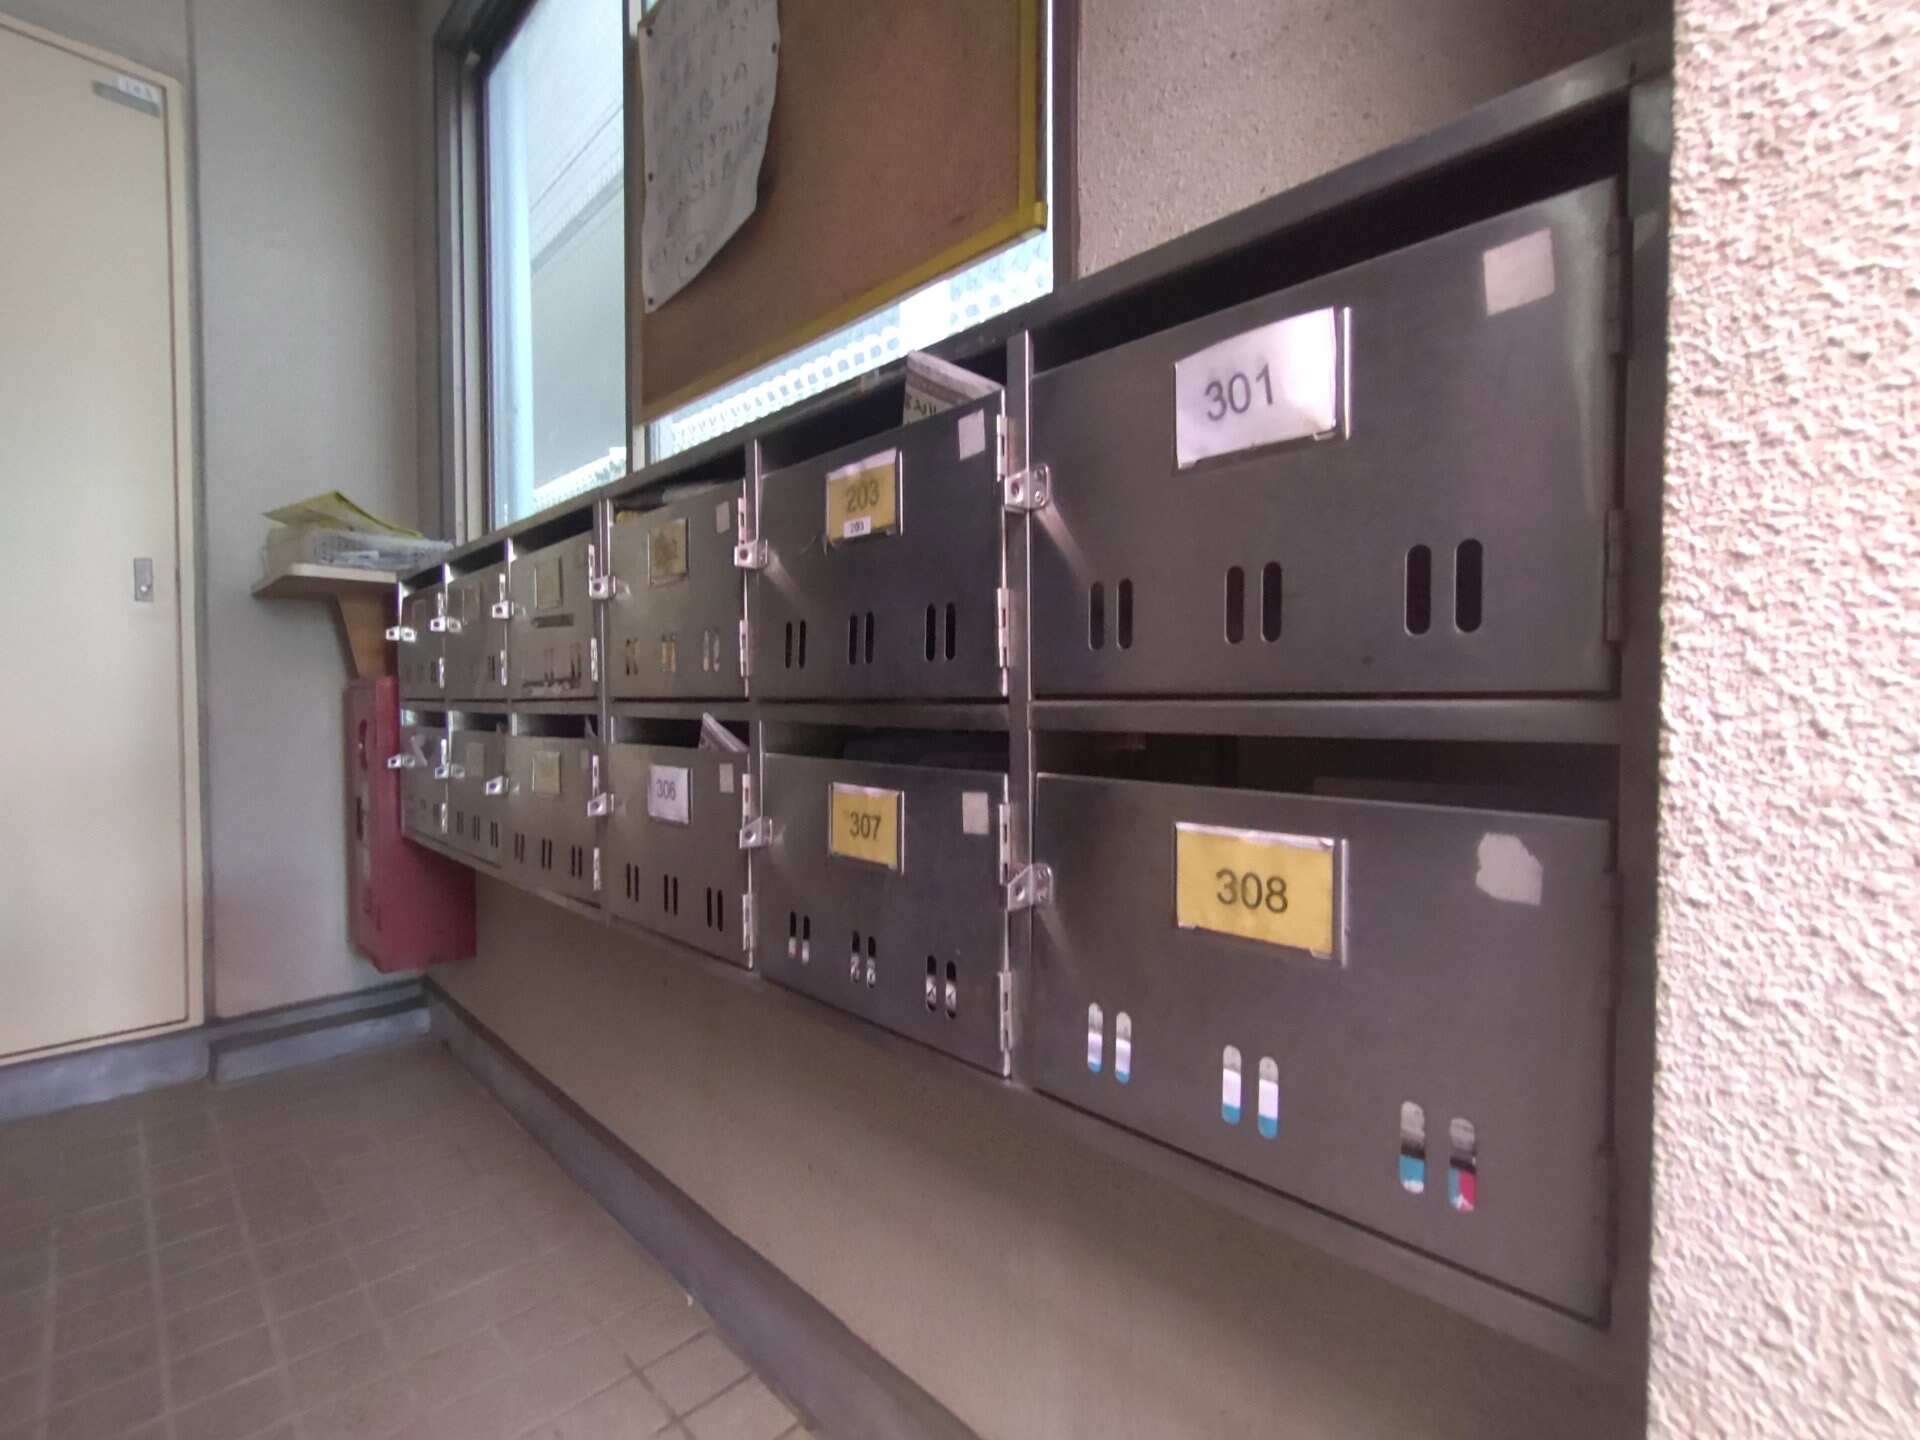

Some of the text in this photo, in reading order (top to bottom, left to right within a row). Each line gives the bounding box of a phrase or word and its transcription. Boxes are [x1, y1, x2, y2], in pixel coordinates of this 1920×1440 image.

[1204, 363, 1273, 422] 301
[846, 477, 880, 513] 203
[850, 520, 864, 534] 203
[656, 779, 676, 801] 306
[849, 811, 882, 840] 307
[1216, 868, 1288, 914] 308
